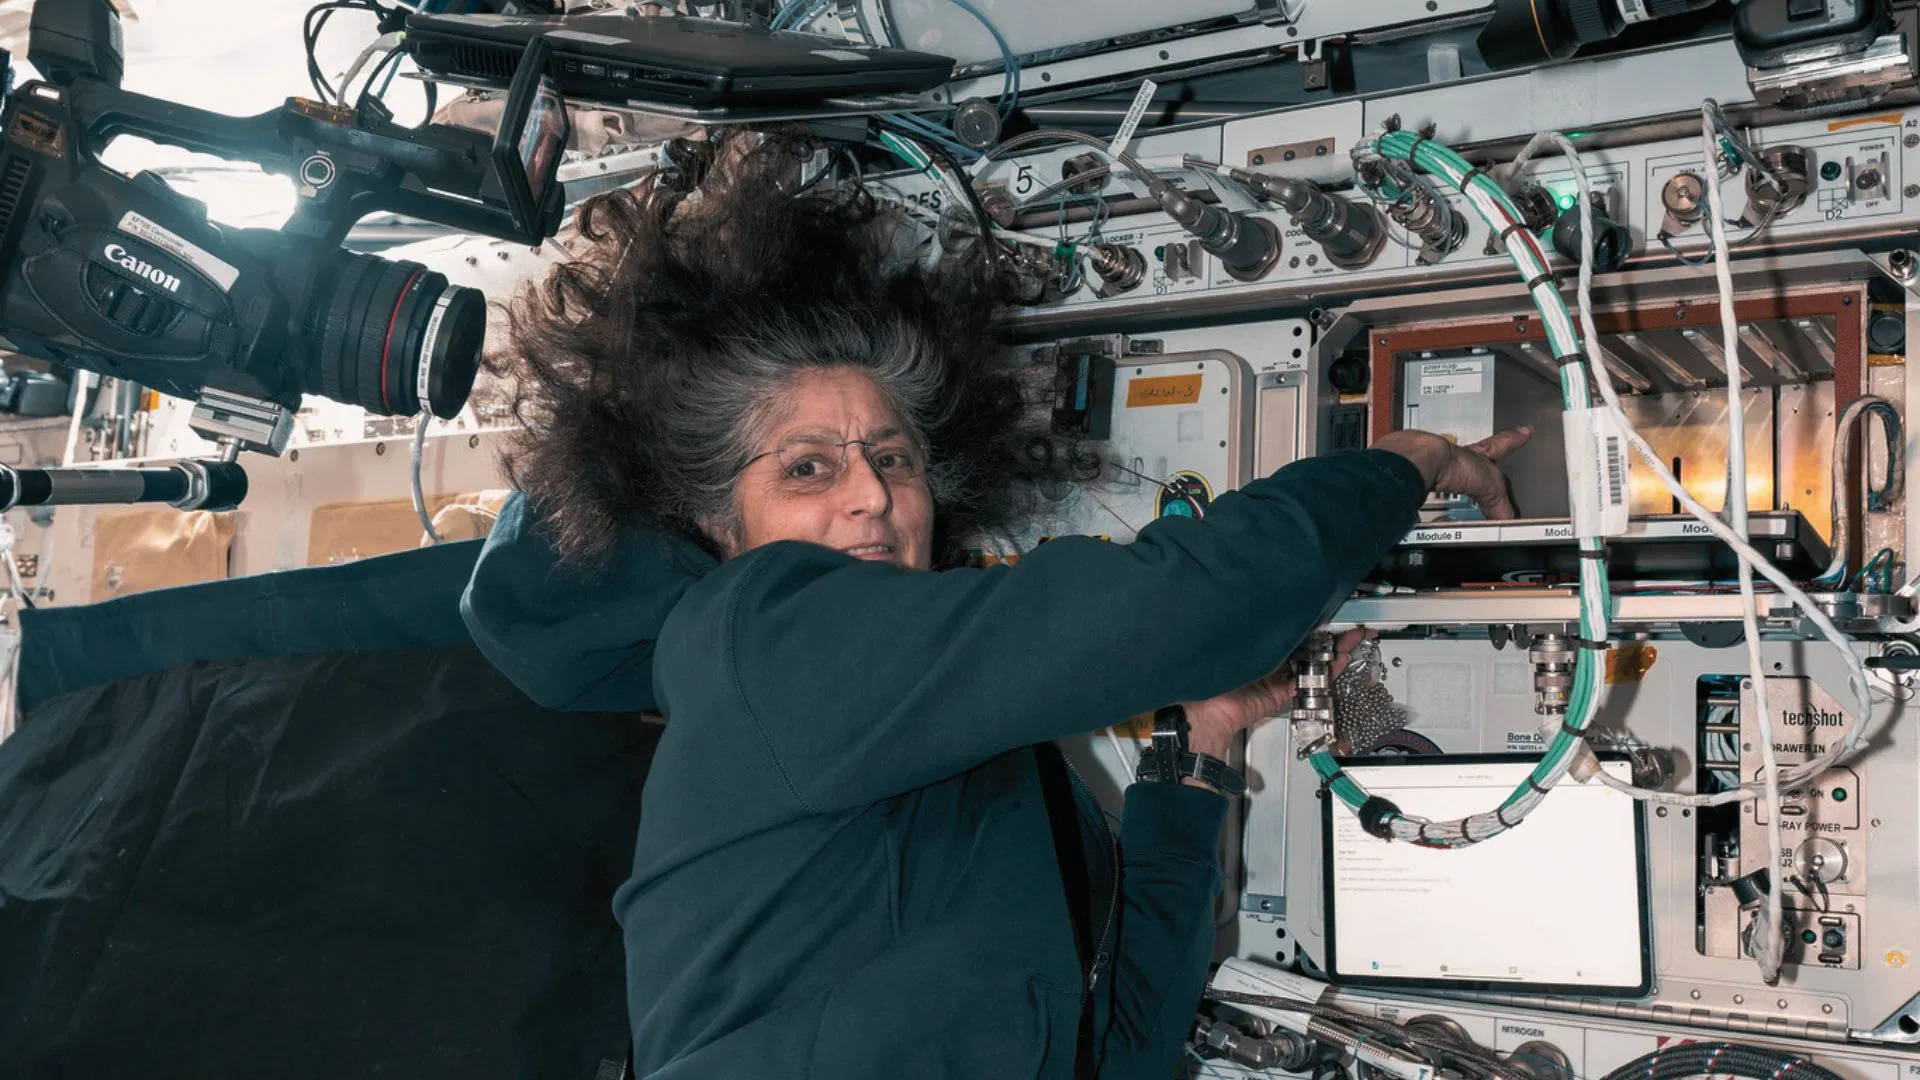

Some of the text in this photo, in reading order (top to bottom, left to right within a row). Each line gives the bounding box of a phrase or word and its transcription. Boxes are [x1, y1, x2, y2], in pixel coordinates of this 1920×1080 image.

[1905, 120, 1918, 128] A2
[1016, 165, 1033, 194] 5
[1825, 208, 1843, 220] D2
[104, 243, 181, 293] Canon
[1416, 532, 1452, 541] Module
[1454, 531, 1463, 540] B
[1782, 707, 1844, 727] techshot
[1507, 732, 1532, 741] Bone
[1814, 744, 1825, 754] IN
[1779, 821, 1841, 832] -RAY POWER
[1782, 858, 1793, 868] J2
[1501, 1025, 1545, 1038] NITROGEN
